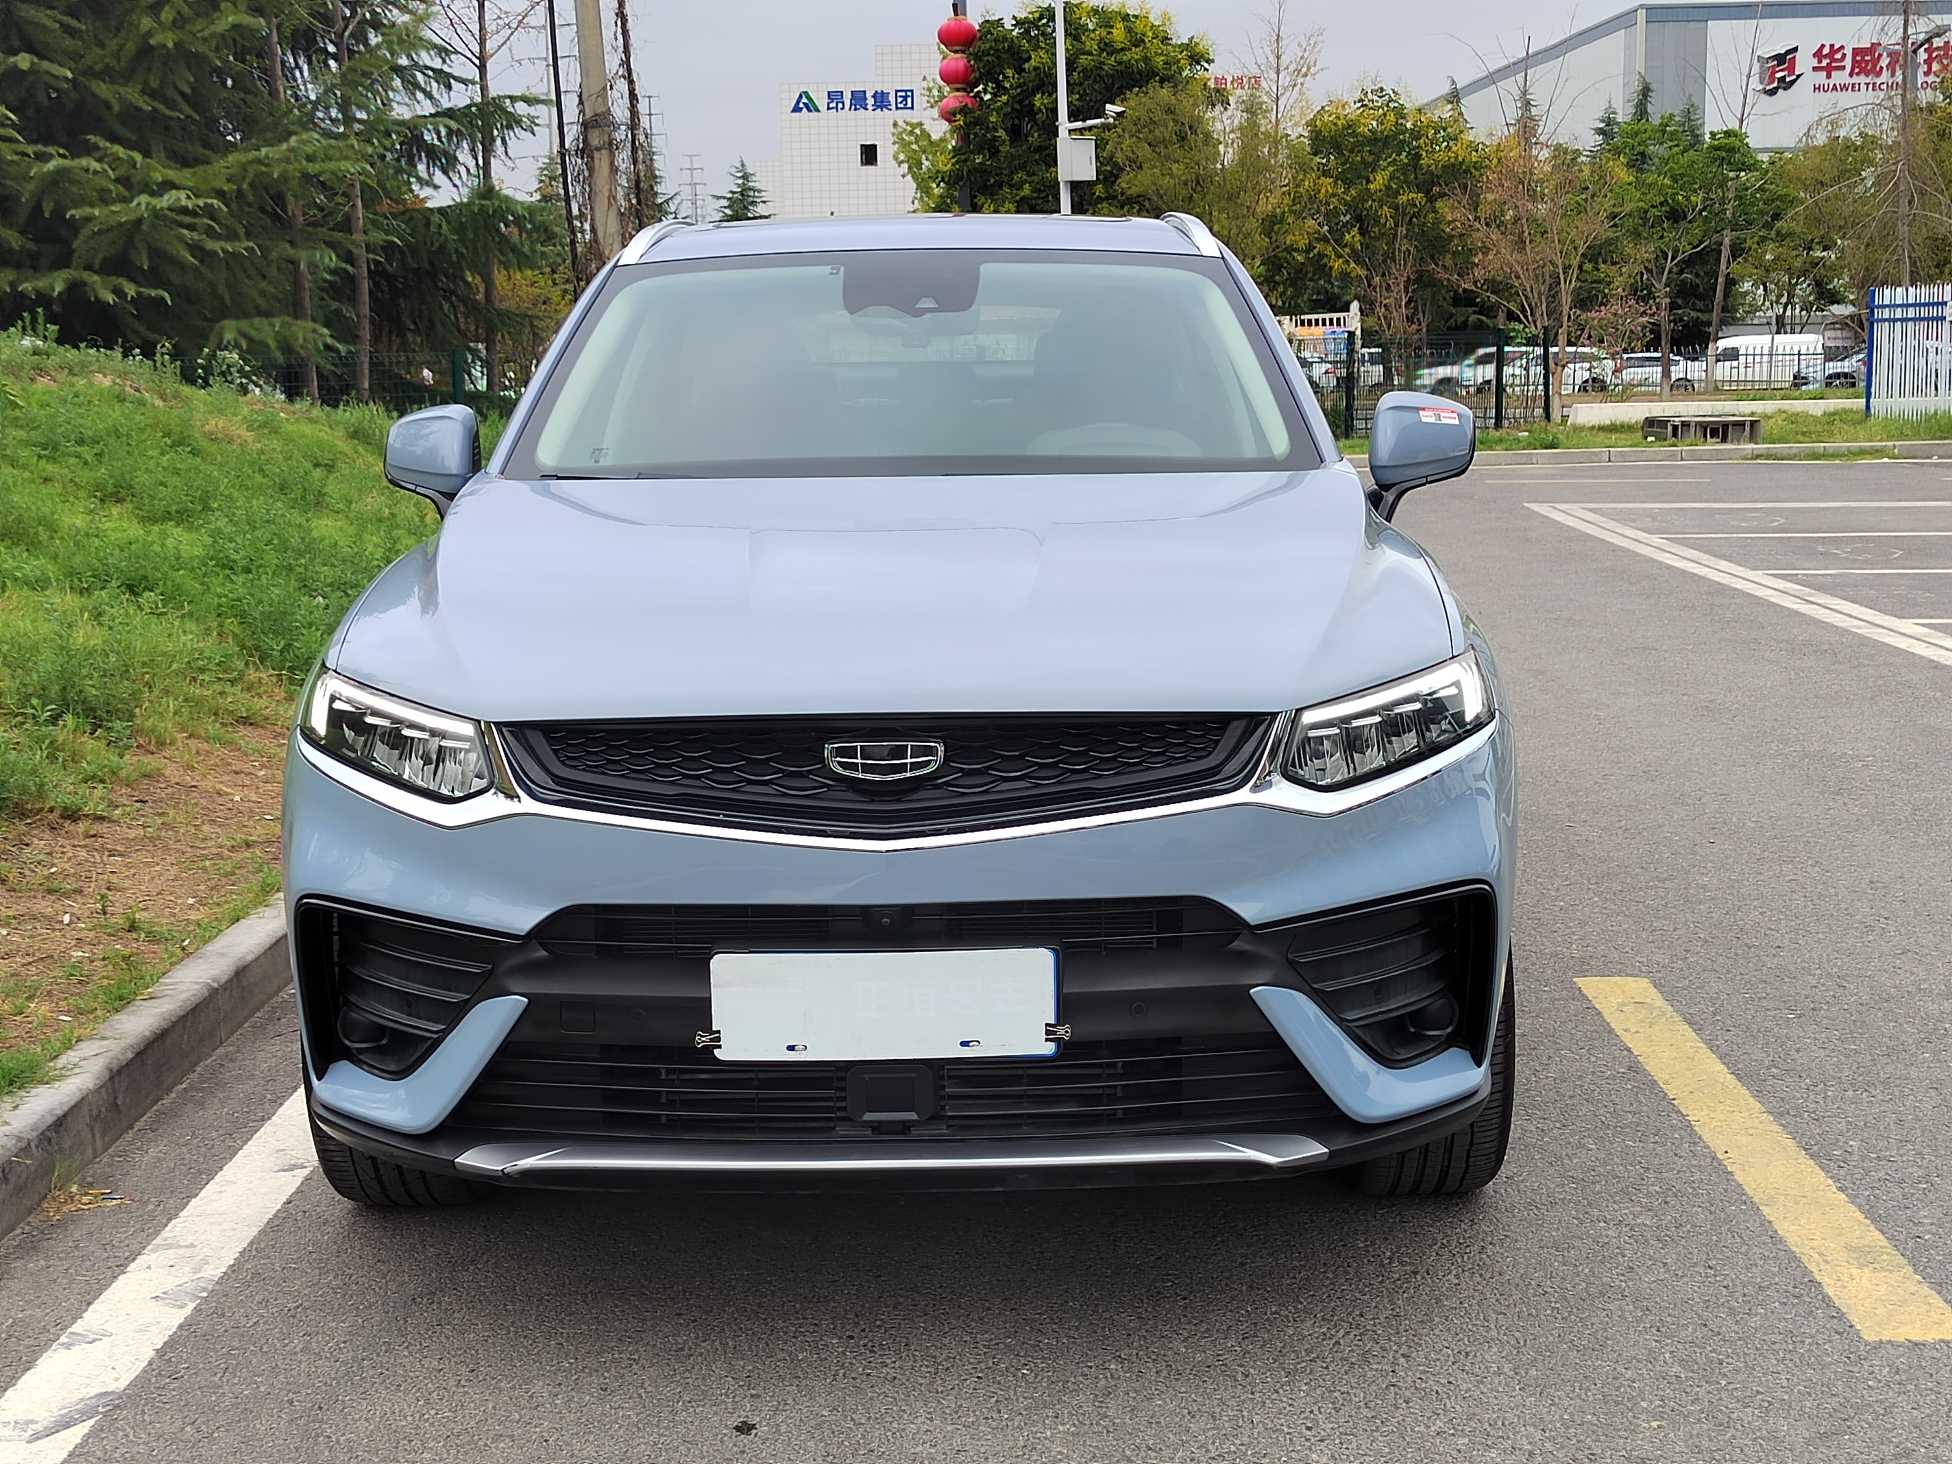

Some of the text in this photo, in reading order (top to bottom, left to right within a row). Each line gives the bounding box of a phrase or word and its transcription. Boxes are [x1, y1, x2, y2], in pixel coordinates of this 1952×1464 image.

[1813, 82, 1861, 93] HUAWEI
[826, 88, 915, 112] 昂晨集团
